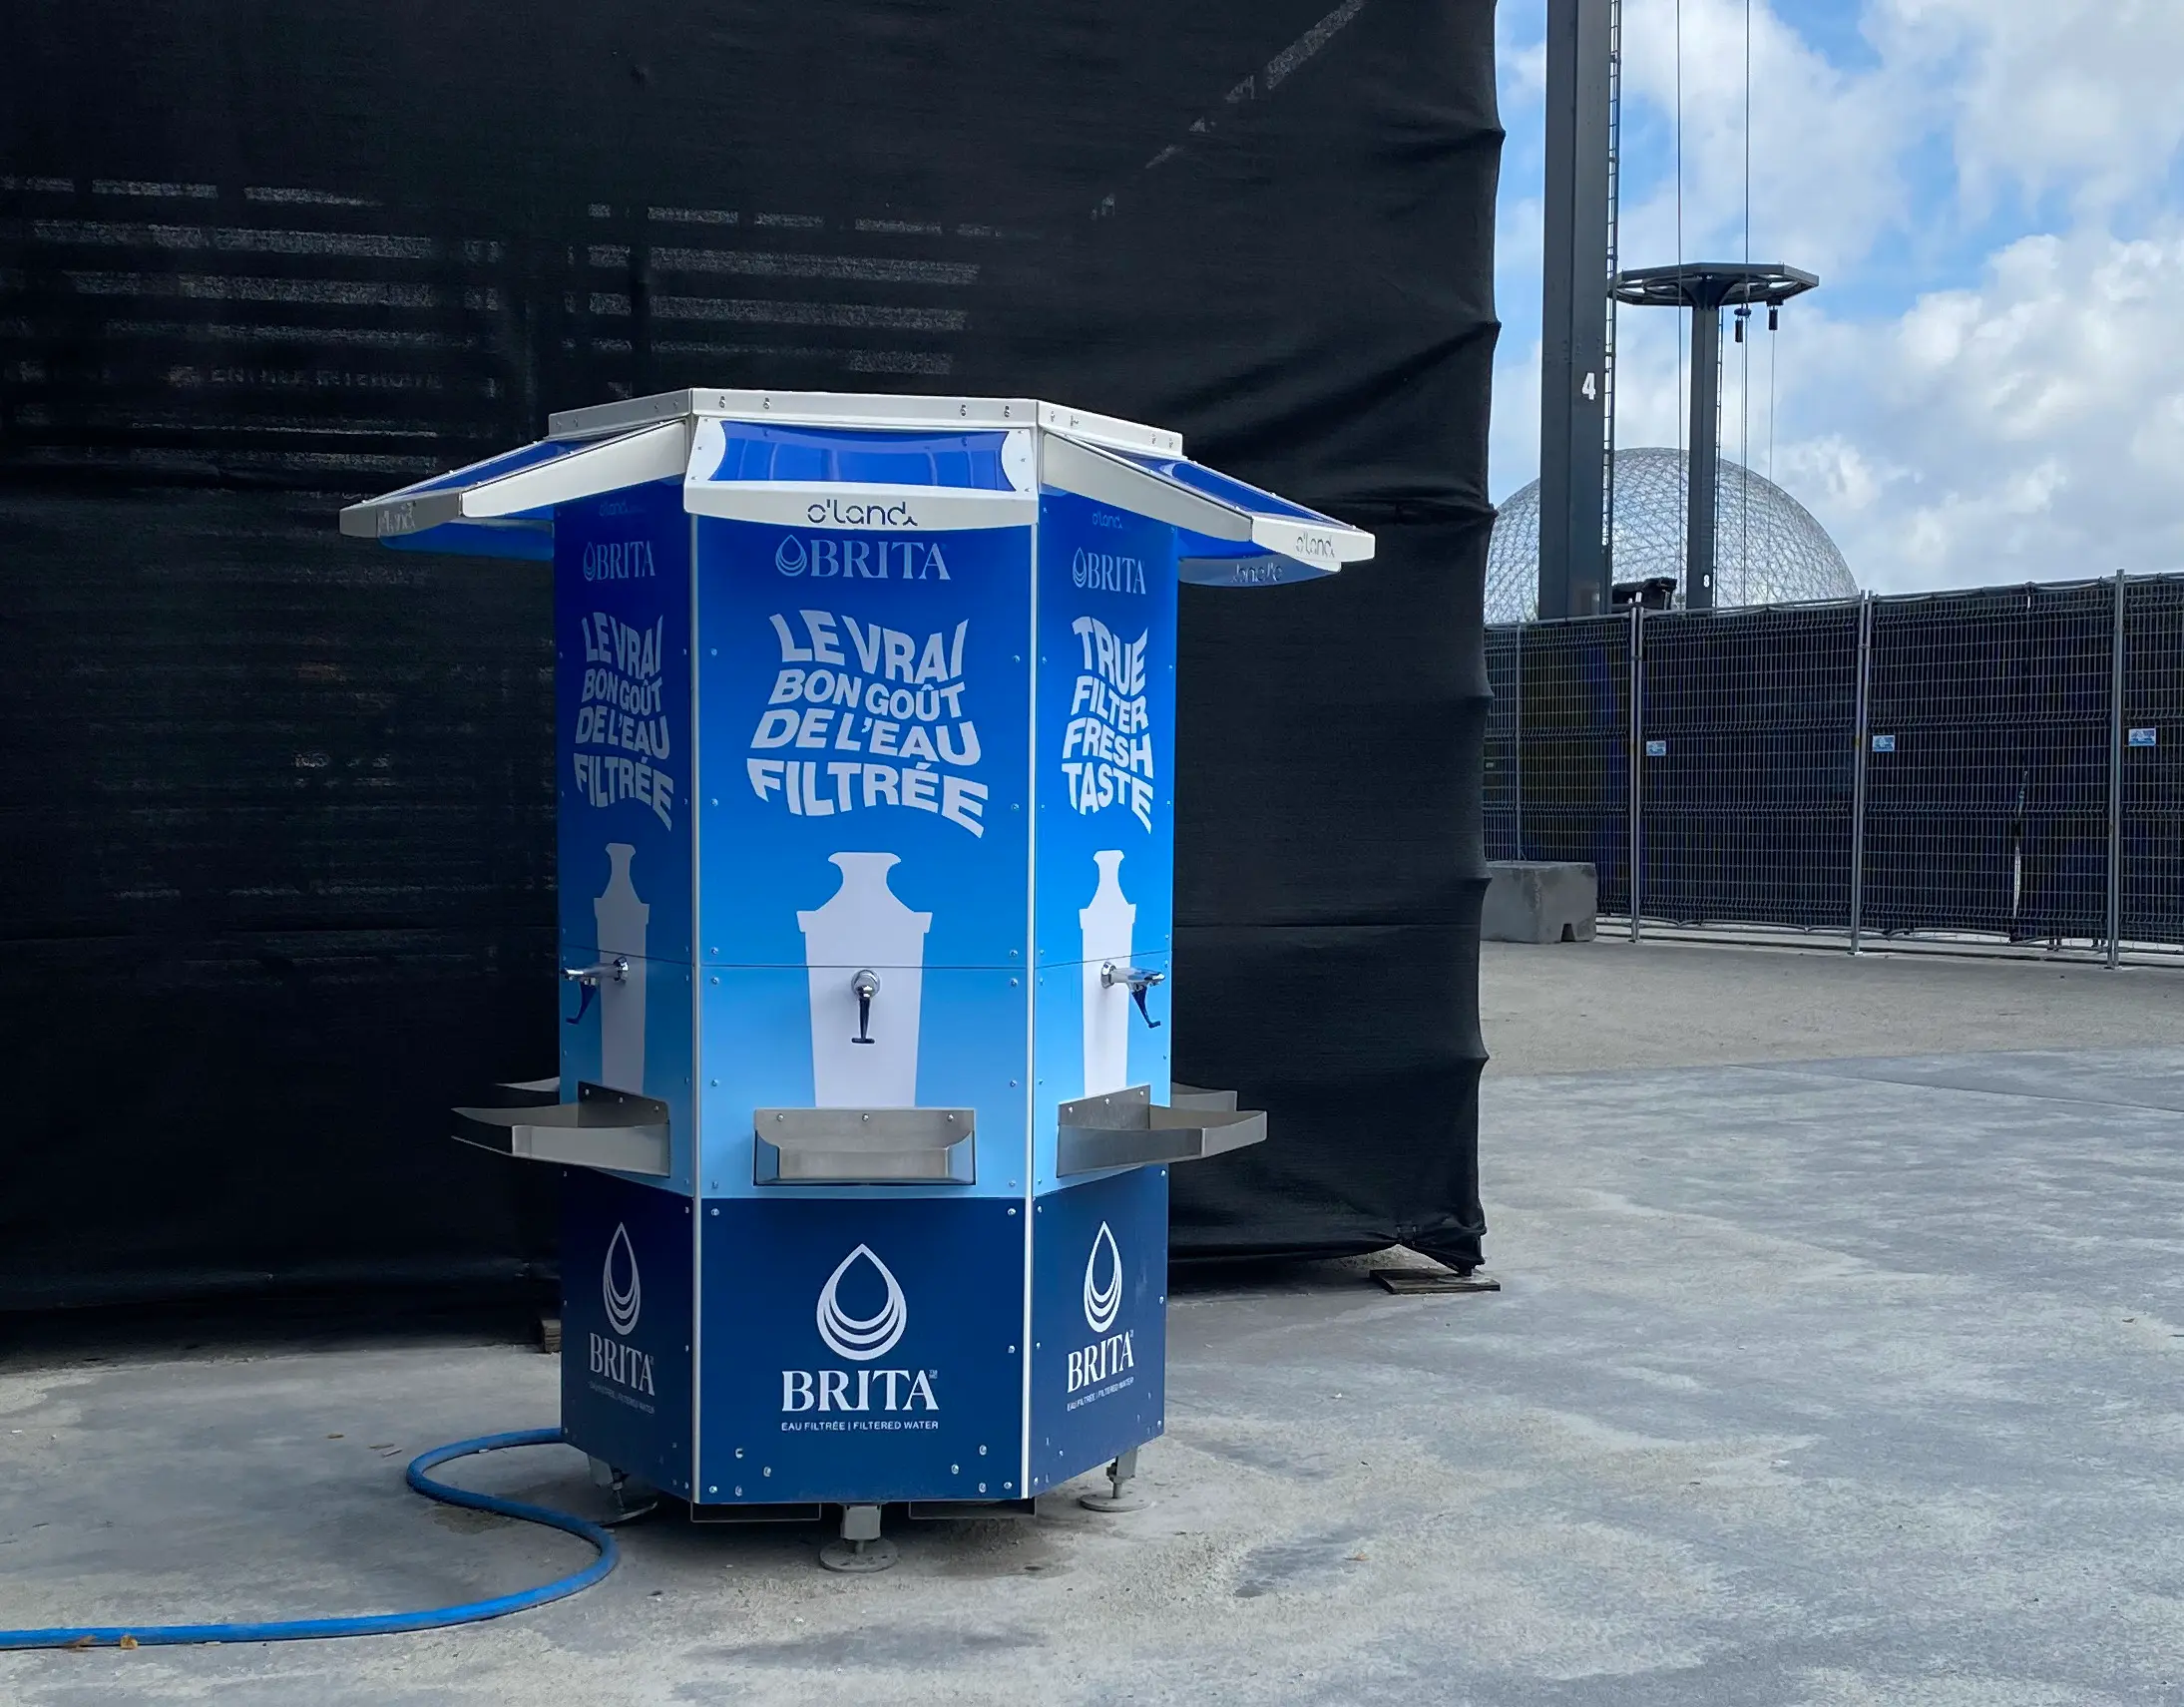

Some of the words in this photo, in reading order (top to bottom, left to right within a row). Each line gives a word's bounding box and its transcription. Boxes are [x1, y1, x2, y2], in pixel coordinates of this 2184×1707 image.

[1581, 372, 1596, 400] 4
[599, 540, 656, 581] BRITA
[809, 539, 952, 581] BRITA
[1088, 552, 1147, 596] BRITA
[581, 612, 612, 663] LE
[610, 615, 664, 680] VRAI
[768, 610, 846, 666] LE
[841, 615, 970, 684] VRAI
[1072, 616, 1148, 696] TRUE
[581, 667, 619, 704] BON
[619, 675, 663, 716] GOÛT
[767, 668, 862, 708] BON
[865, 681, 966, 722] GOÛT
[1071, 674, 1149, 735] FILTER
[575, 704, 609, 745] DE
[608, 711, 671, 760] L'EAU
[750, 707, 836, 749] DE
[834, 711, 982, 766] L'EAU
[1063, 716, 1154, 780] FRESH
[573, 752, 673, 832] FILTRÉE
[746, 756, 989, 839] FILTRÉE
[1062, 761, 1154, 835] TASTE
[590, 1332, 655, 1397] BRITA
[781, 1370, 940, 1412] BRITA
[1067, 1331, 1134, 1394] BRITA
[781, 1422, 802, 1432] EAU
[804, 1421, 846, 1432] FILTRÉE
[853, 1421, 902, 1431] FILTERED
[903, 1421, 939, 1430] WATER
